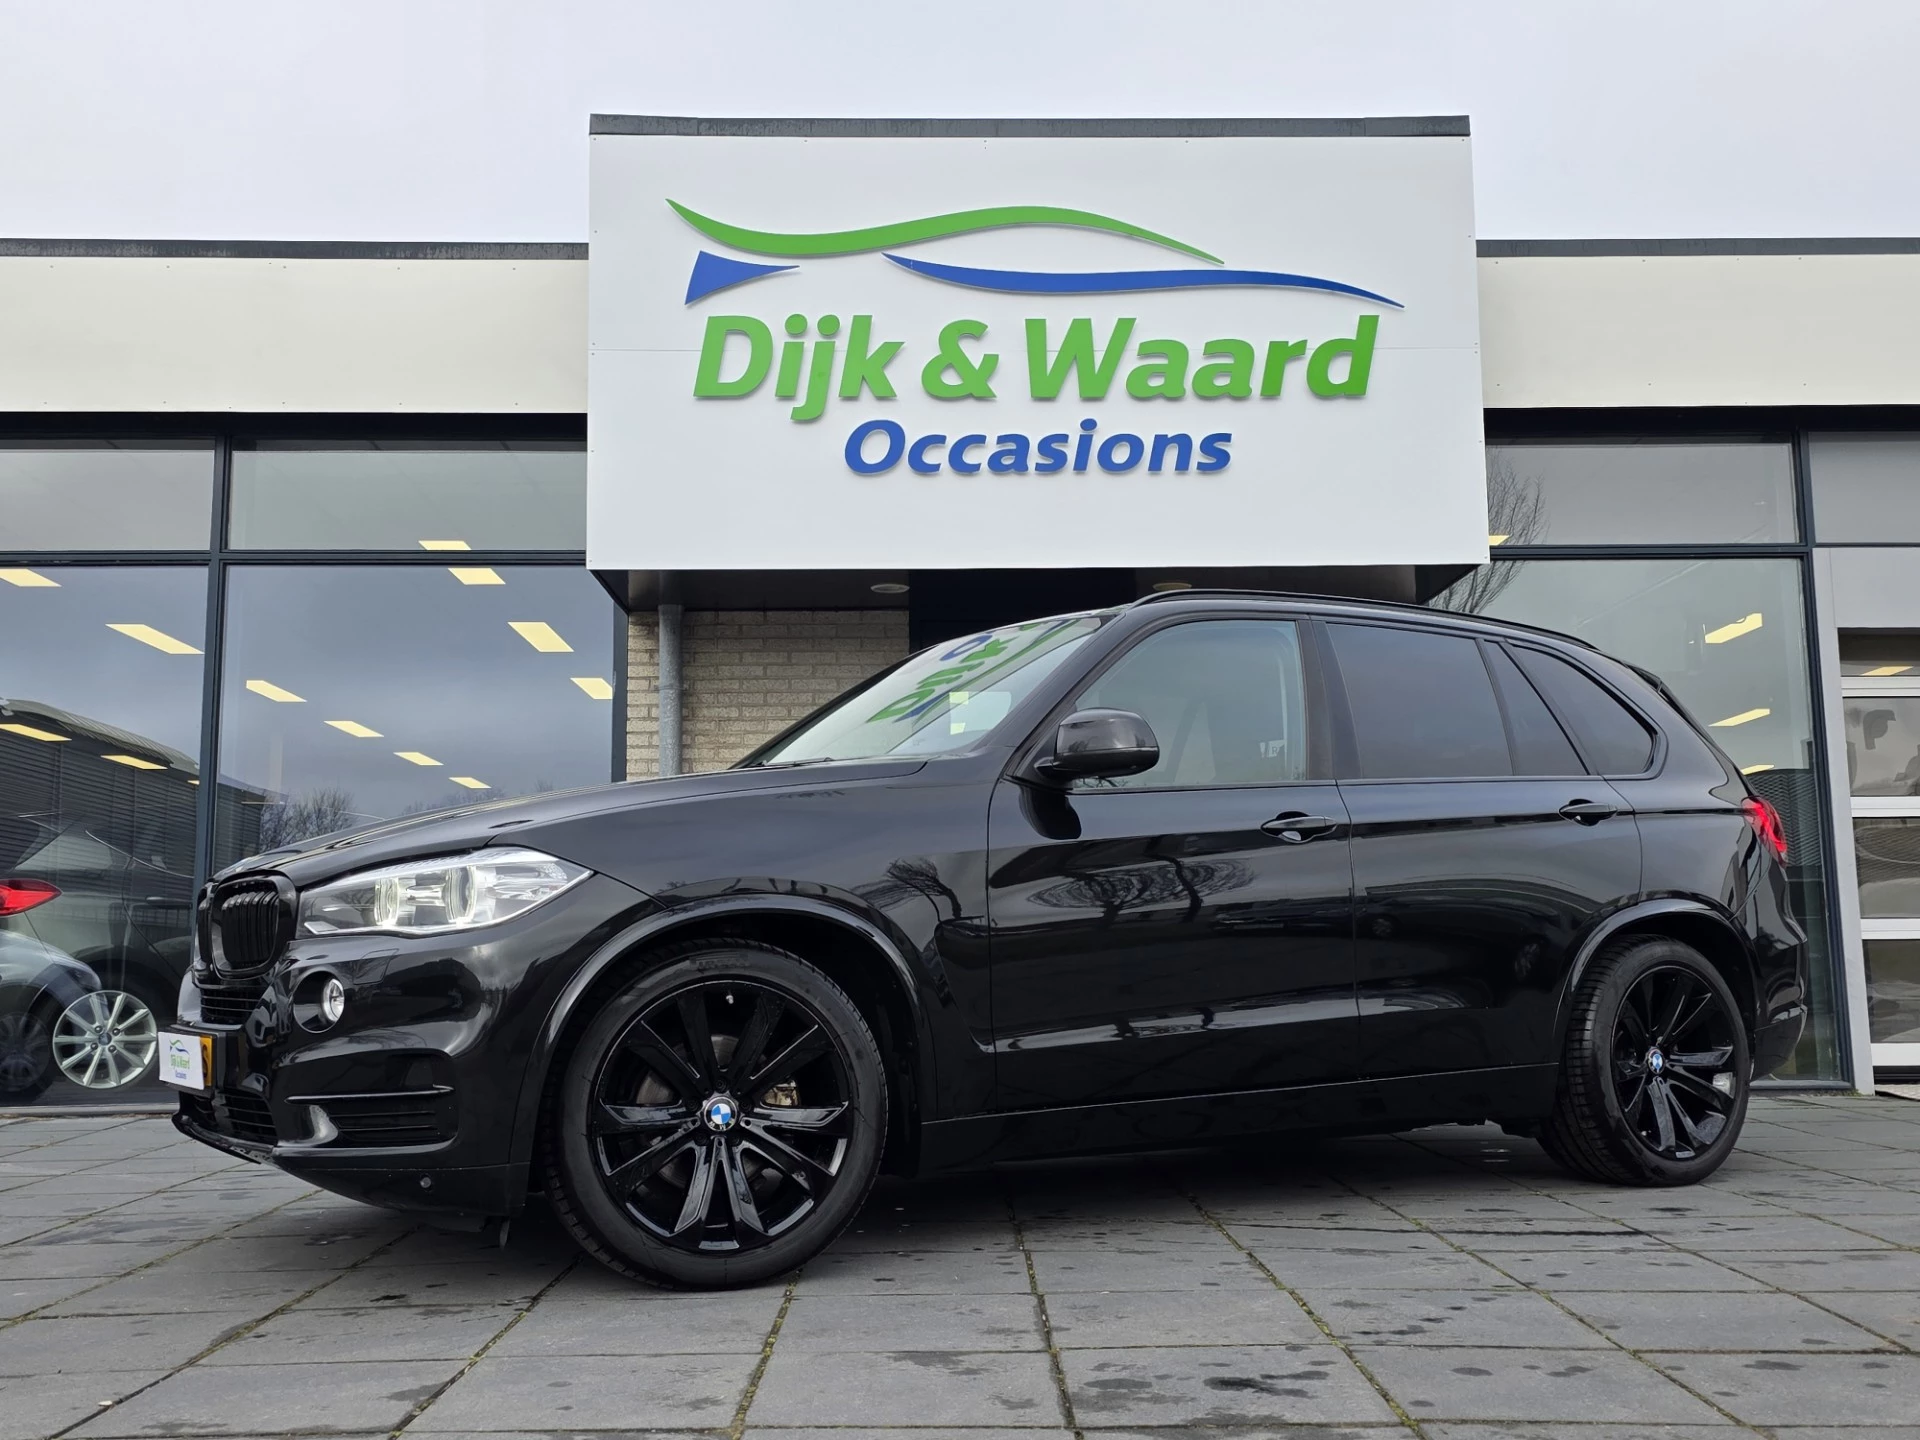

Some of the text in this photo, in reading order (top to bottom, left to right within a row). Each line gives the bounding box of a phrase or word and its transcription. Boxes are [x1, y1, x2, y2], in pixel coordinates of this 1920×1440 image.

[694, 314, 1380, 421] Dijk & Waard
[844, 418, 1232, 474] Occasions
